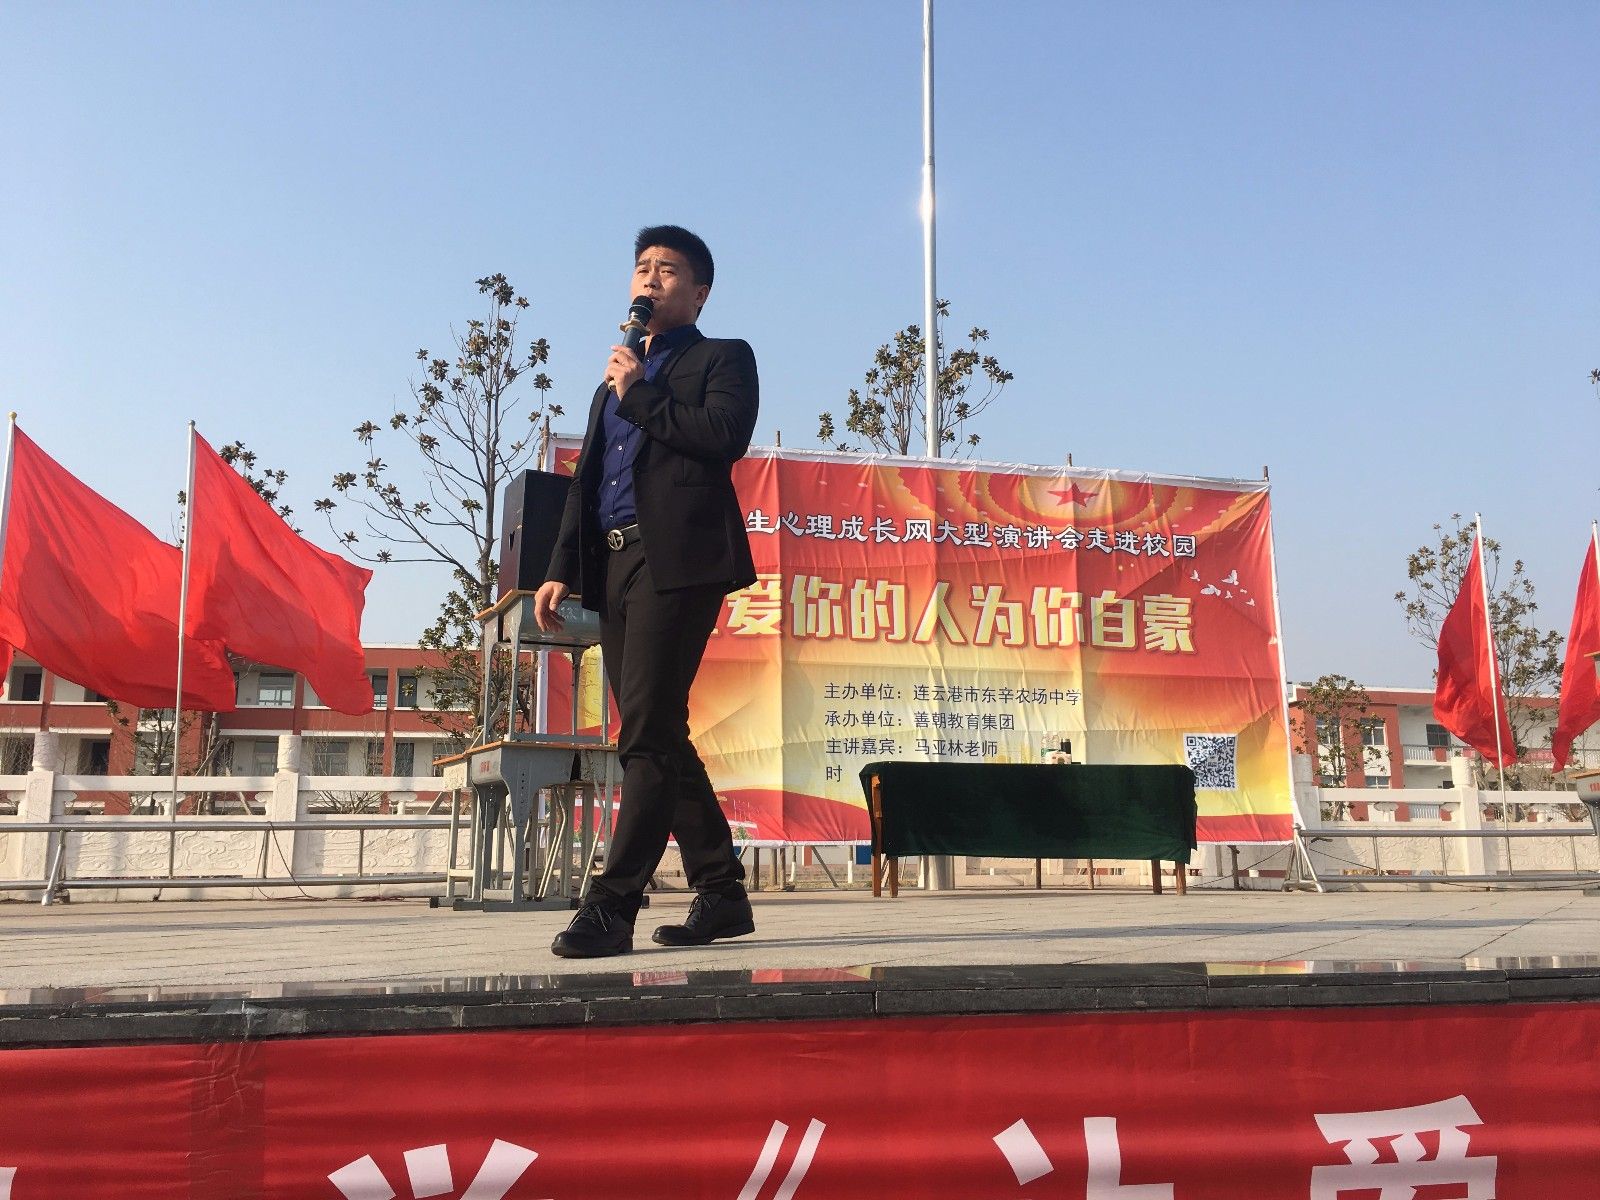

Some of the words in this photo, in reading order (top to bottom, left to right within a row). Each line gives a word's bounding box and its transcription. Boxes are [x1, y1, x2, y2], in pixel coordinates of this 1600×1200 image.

[746, 509, 1196, 557] 生心理成长网大型演讲会走进校园
[711, 573, 1194, 652] 爱你的人为你自豪
[826, 765, 842, 782] 时
